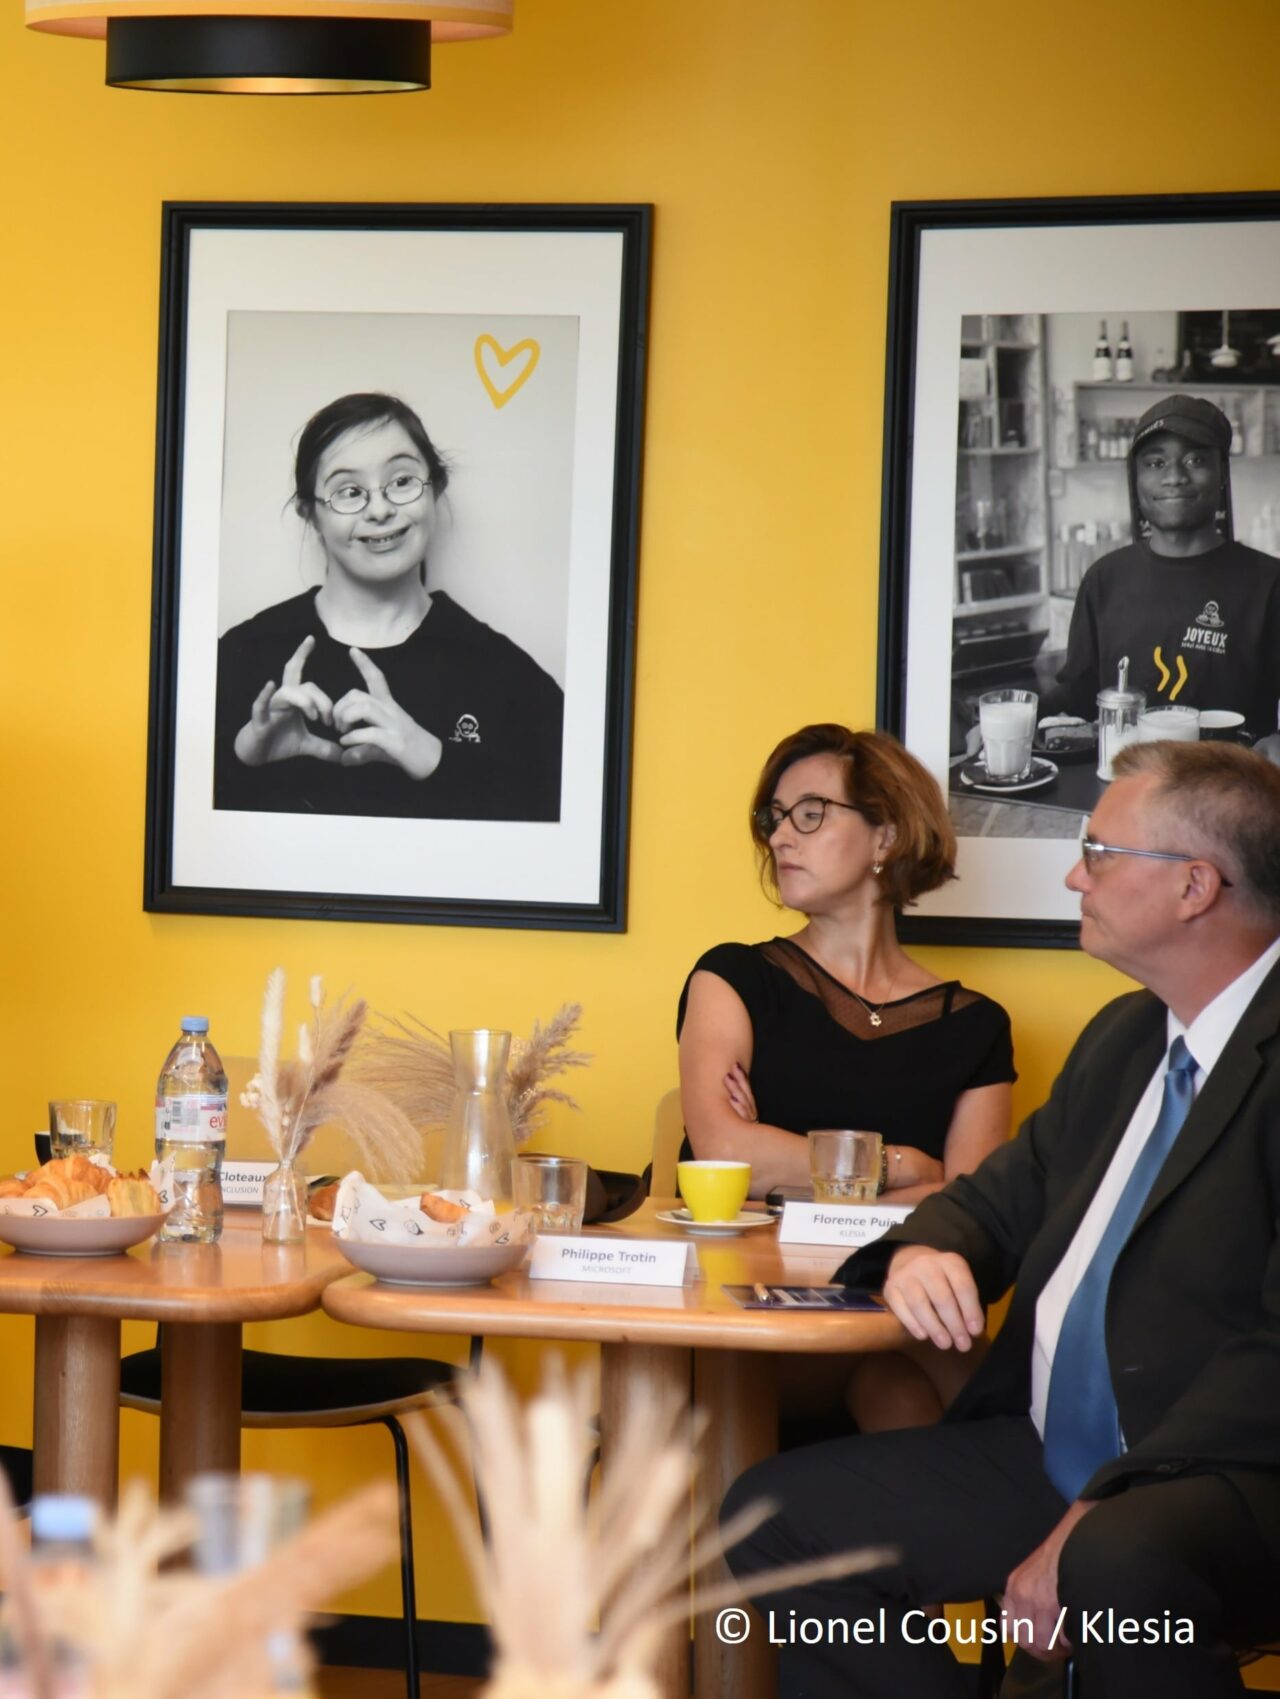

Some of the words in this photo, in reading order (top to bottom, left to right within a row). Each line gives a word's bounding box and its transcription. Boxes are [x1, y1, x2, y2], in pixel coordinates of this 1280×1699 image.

[1183, 627, 1228, 647] JOYEUX
[813, 1214, 866, 1226] Florence
[561, 1248, 614, 1262] Philippe
[619, 1251, 656, 1263] Trotin
[582, 1265, 632, 1274] MICROSOFT
